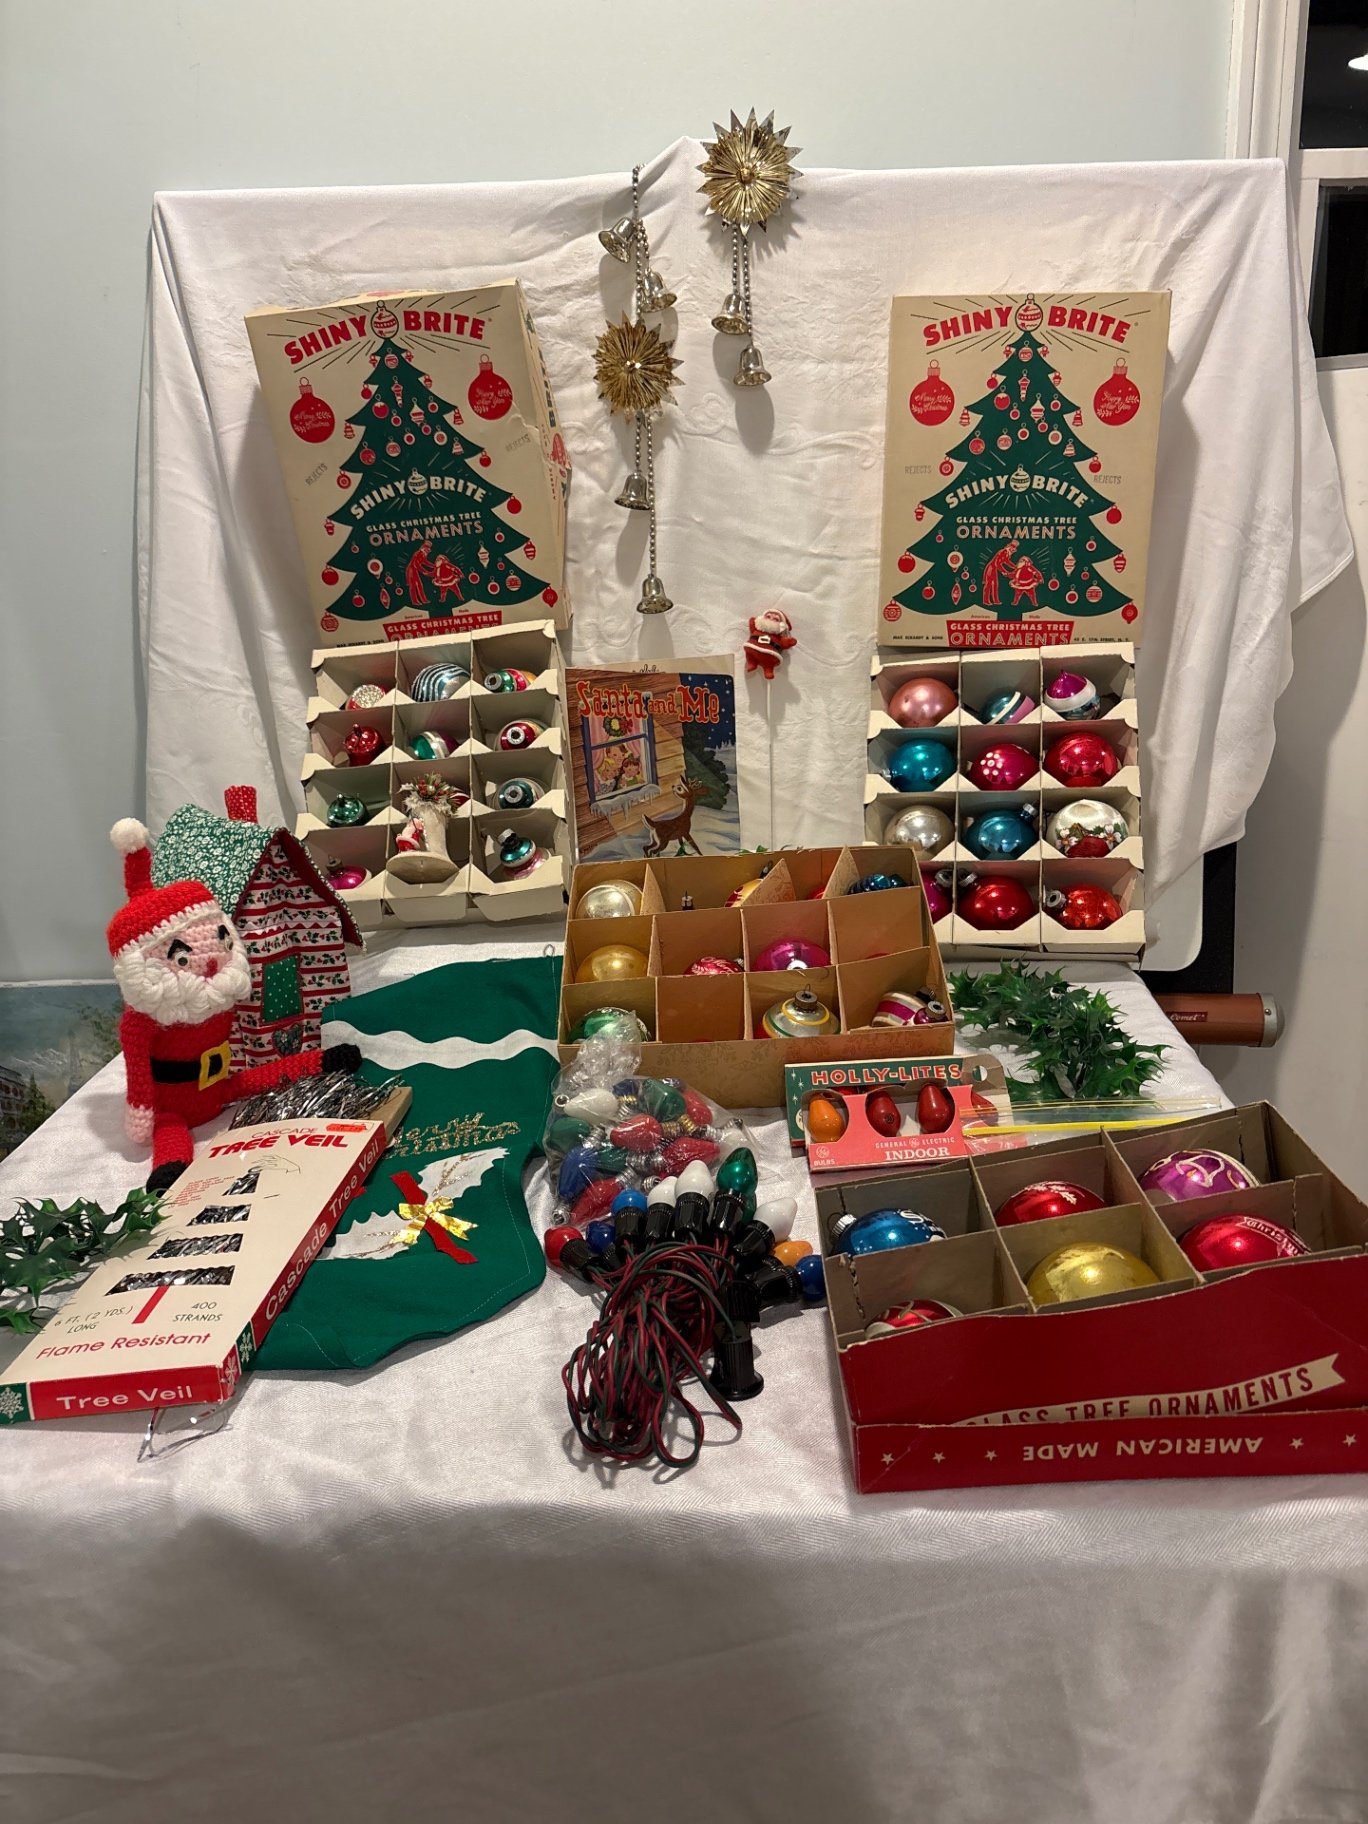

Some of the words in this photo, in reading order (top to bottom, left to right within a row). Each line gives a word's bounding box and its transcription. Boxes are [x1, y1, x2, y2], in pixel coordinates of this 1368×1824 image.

[923, 306, 1012, 346] SHINY
[1048, 305, 1131, 343] BRITE
[284, 315, 367, 365] SHINY
[403, 311, 485, 340] BRITE
[904, 465, 932, 475] REJECTS
[1093, 474, 1122, 485] REJECTS
[350, 480, 406, 520] SHINY
[429, 476, 487, 503] BRITE
[945, 474, 1009, 509] SHINY
[1032, 475, 1089, 509] BRITE
[366, 522, 397, 533] GLASS
[400, 514, 455, 528] CHRISTMAS
[459, 511, 481, 520] TREE
[956, 516, 988, 524] GLASS
[992, 516, 1050, 524] CHRISTMAS
[1054, 516, 1077, 524] TREE
[369, 520, 484, 547] ORNAMENTS
[956, 526, 1077, 541] ORNAMENTS
[387, 624, 418, 633] GLASS
[421, 616, 474, 629] CHRISTMAS
[477, 613, 499, 622] TREE
[950, 623, 982, 631] GLASS
[986, 623, 1043, 631] CHRISTMAS
[1046, 623, 1070, 631] TREE
[950, 632, 1069, 646] ORNAMENTS
[576, 681, 648, 720] Santa
[648, 693, 677, 715] and
[676, 684, 720, 724] Me
[811, 1064, 962, 1086] HOLLY-LITES
[252, 1127, 317, 1138] CASCADE
[208, 1135, 280, 1158] TREE
[287, 1134, 348, 1148] VEIL
[875, 1141, 907, 1149] GENERAL
[922, 1137, 955, 1146] ELECTRIC
[885, 1146, 950, 1160] INDOOR
[265, 1223, 328, 1320] Cascade
[328, 1175, 358, 1219] Tree
[358, 1138, 379, 1173] Veil
[191, 1302, 217, 1310] 400
[66, 1316, 80, 1325] FT.
[67, 1322, 98, 1334] LONG
[172, 1314, 222, 1323] STRANDS
[36, 1340, 105, 1360] Flame
[110, 1332, 211, 1350] Resistant
[56, 1395, 129, 1410] Tree
[137, 1385, 193, 1402] Veil
[1149, 1367, 1313, 1416] ORNAMENTS
[1023, 1442, 1099, 1462] MADE
[1116, 1437, 1263, 1456] AMERICAN
